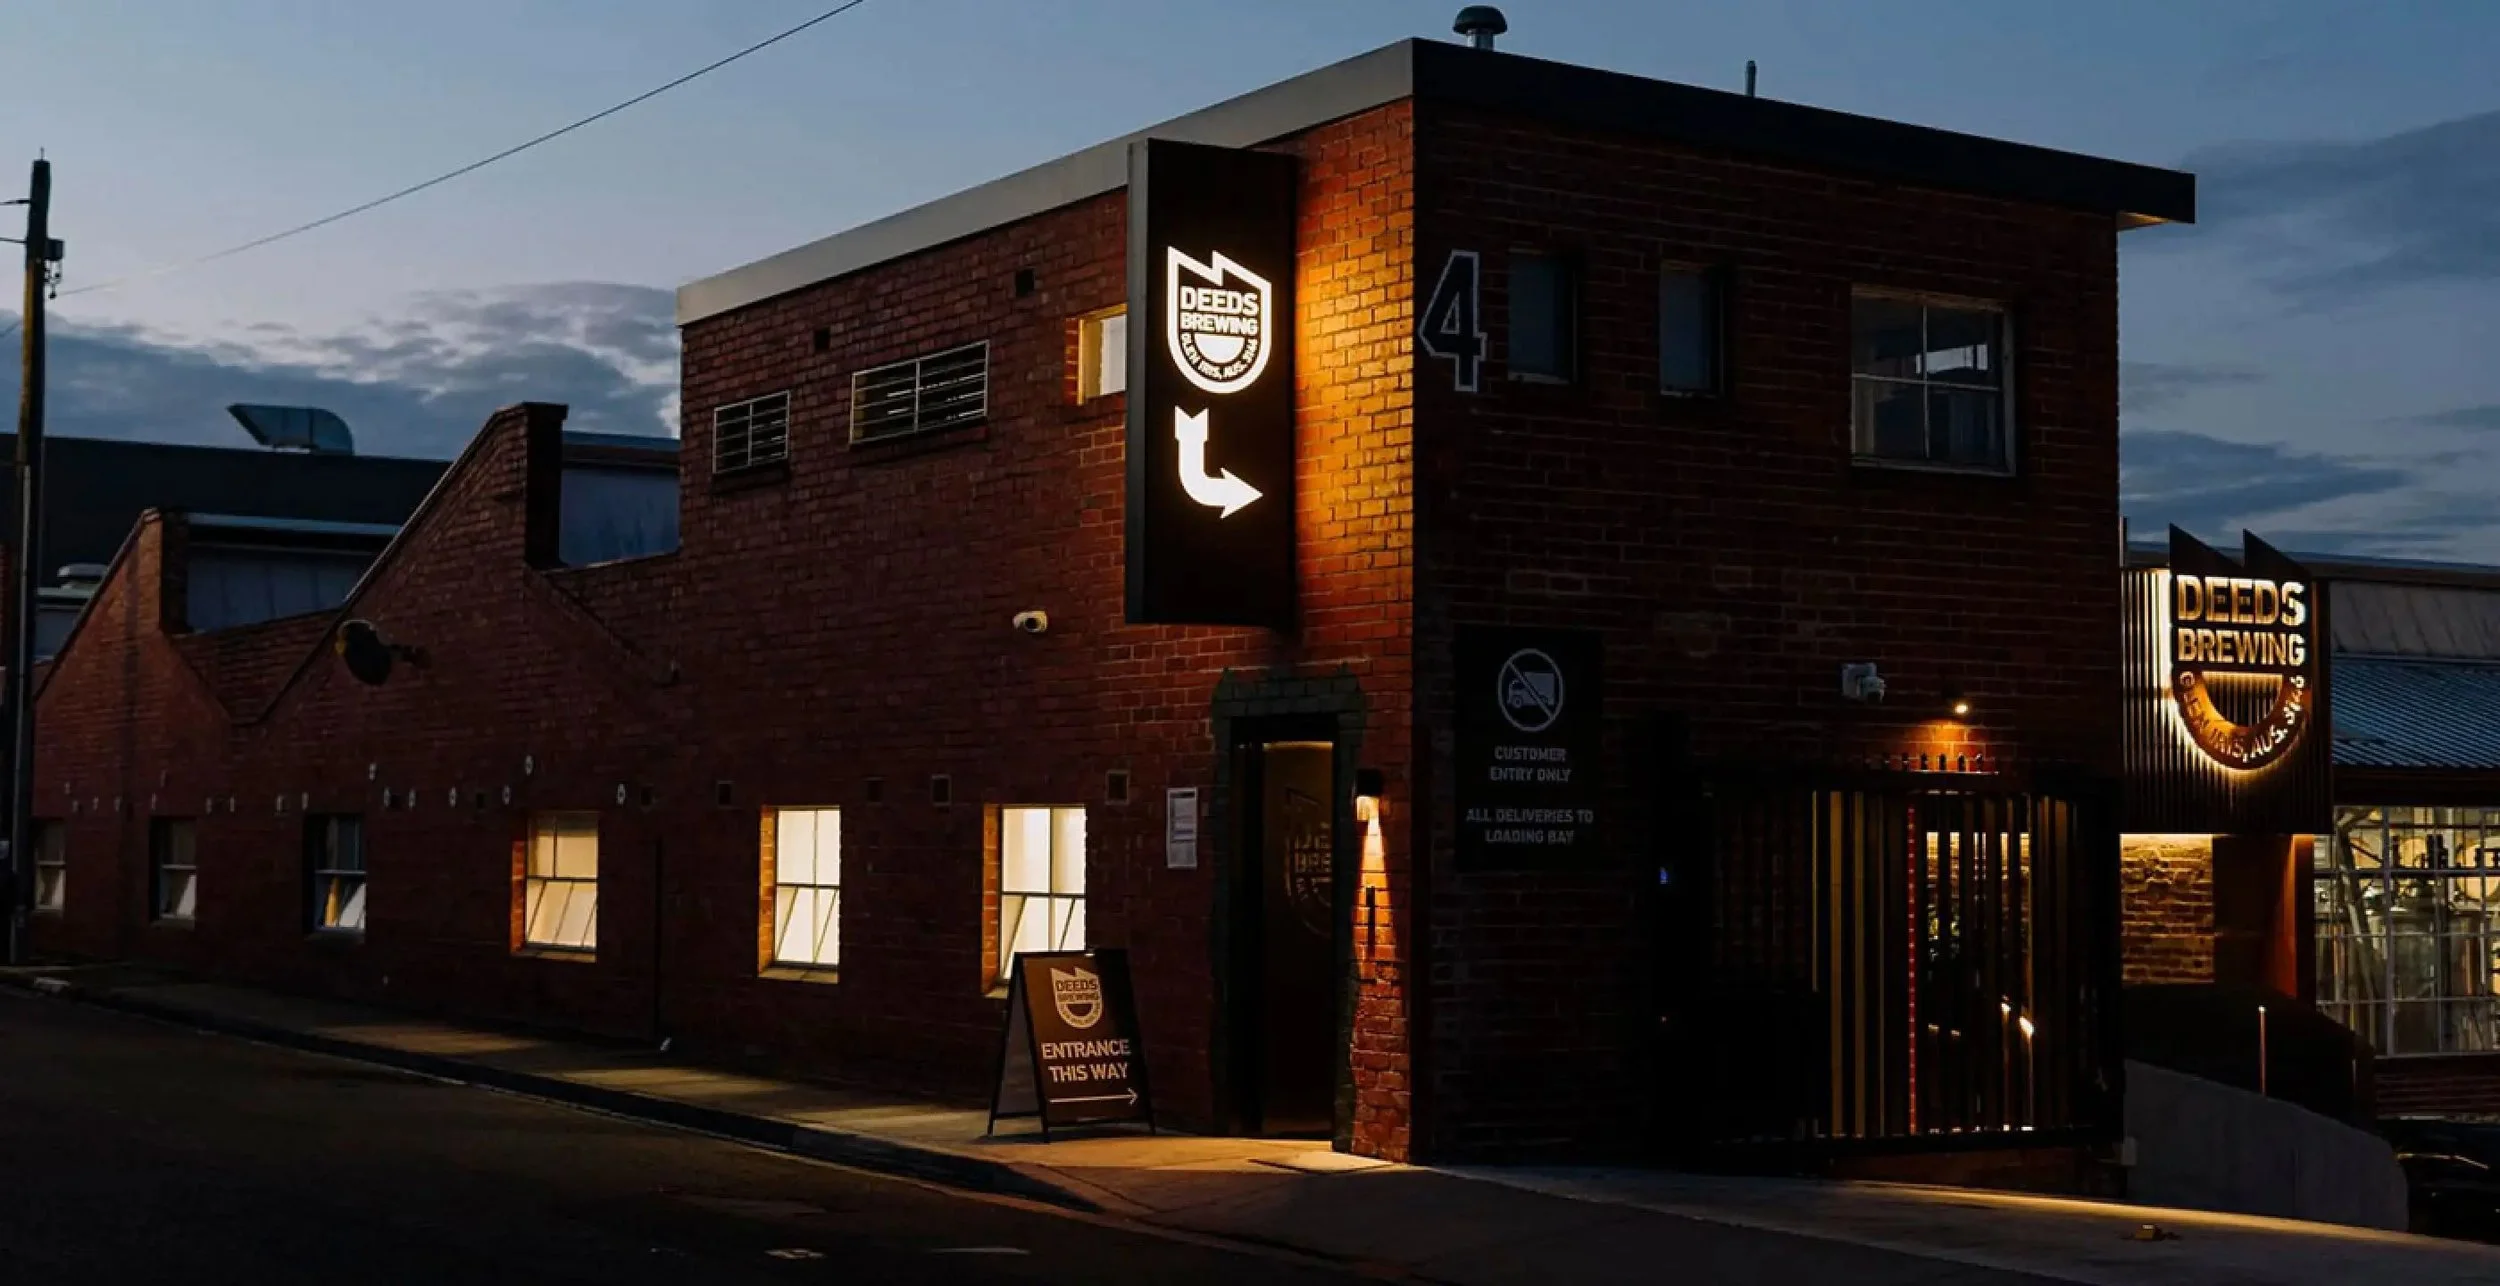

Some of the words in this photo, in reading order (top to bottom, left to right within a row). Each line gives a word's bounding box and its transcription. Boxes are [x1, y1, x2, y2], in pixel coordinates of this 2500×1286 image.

[1180, 285, 1259, 316] DEEDS
[1180, 311, 1258, 335] BREWING
[1418, 249, 1488, 392] 4
[2176, 574, 2305, 626] DEEDS
[2177, 627, 2305, 667] BREWING
[1494, 745, 1567, 762] CUSTOMER
[1490, 766, 1533, 781] ENTRY
[1537, 767, 1572, 782] ONLY
[1466, 807, 1491, 822] ALL
[1495, 807, 1574, 823] DELIVERIES
[1577, 808, 1595, 824] TO
[1485, 828, 1544, 844] LOADING
[1548, 829, 1575, 845] BAY
[1055, 979, 1098, 992] DEEDS
[1041, 1039, 1131, 1060] ENTRANCE
[1048, 1065, 1088, 1083] THIS
[1089, 1062, 1128, 1081] WAY
